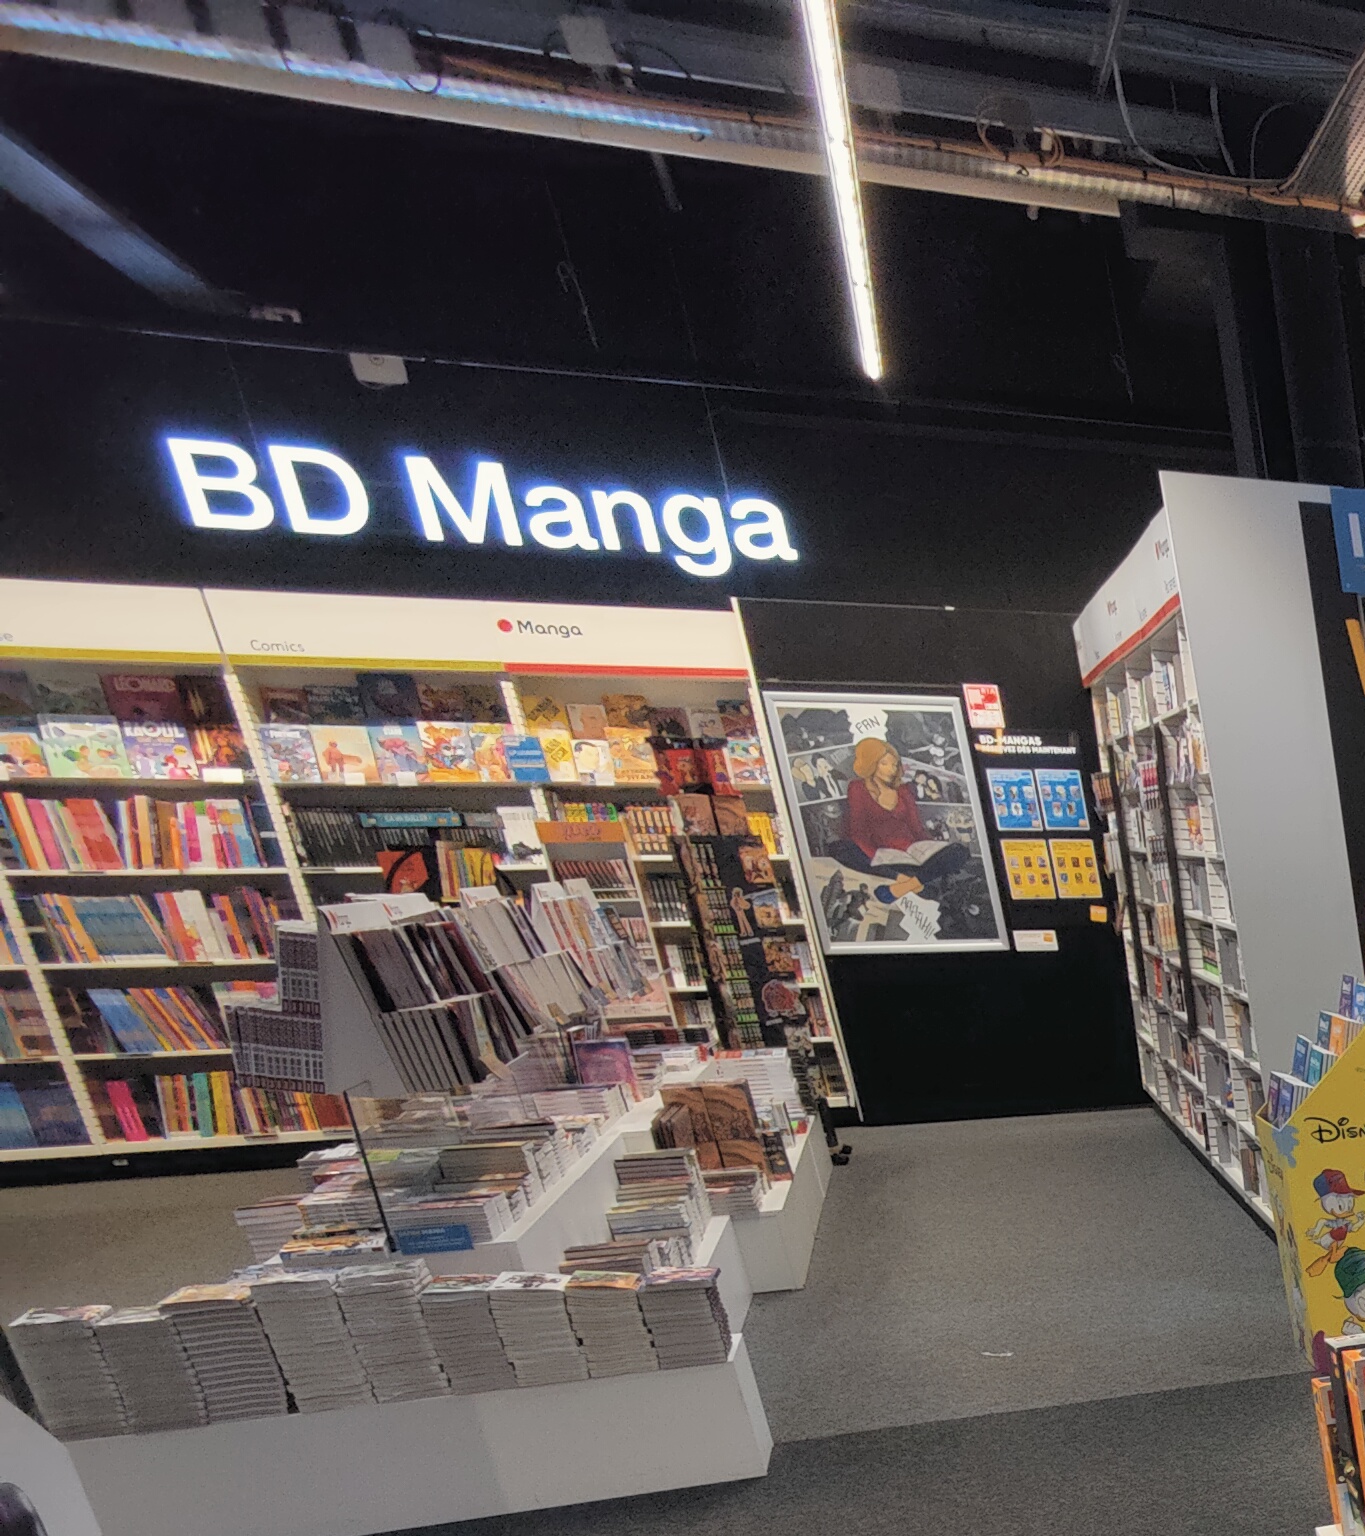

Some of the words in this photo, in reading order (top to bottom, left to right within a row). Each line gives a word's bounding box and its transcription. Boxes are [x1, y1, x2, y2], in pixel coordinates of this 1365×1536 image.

[167, 437, 370, 536] BD
[404, 455, 799, 578] Manga
[517, 619, 583, 639] Manga
[250, 639, 305, 653] Comics
